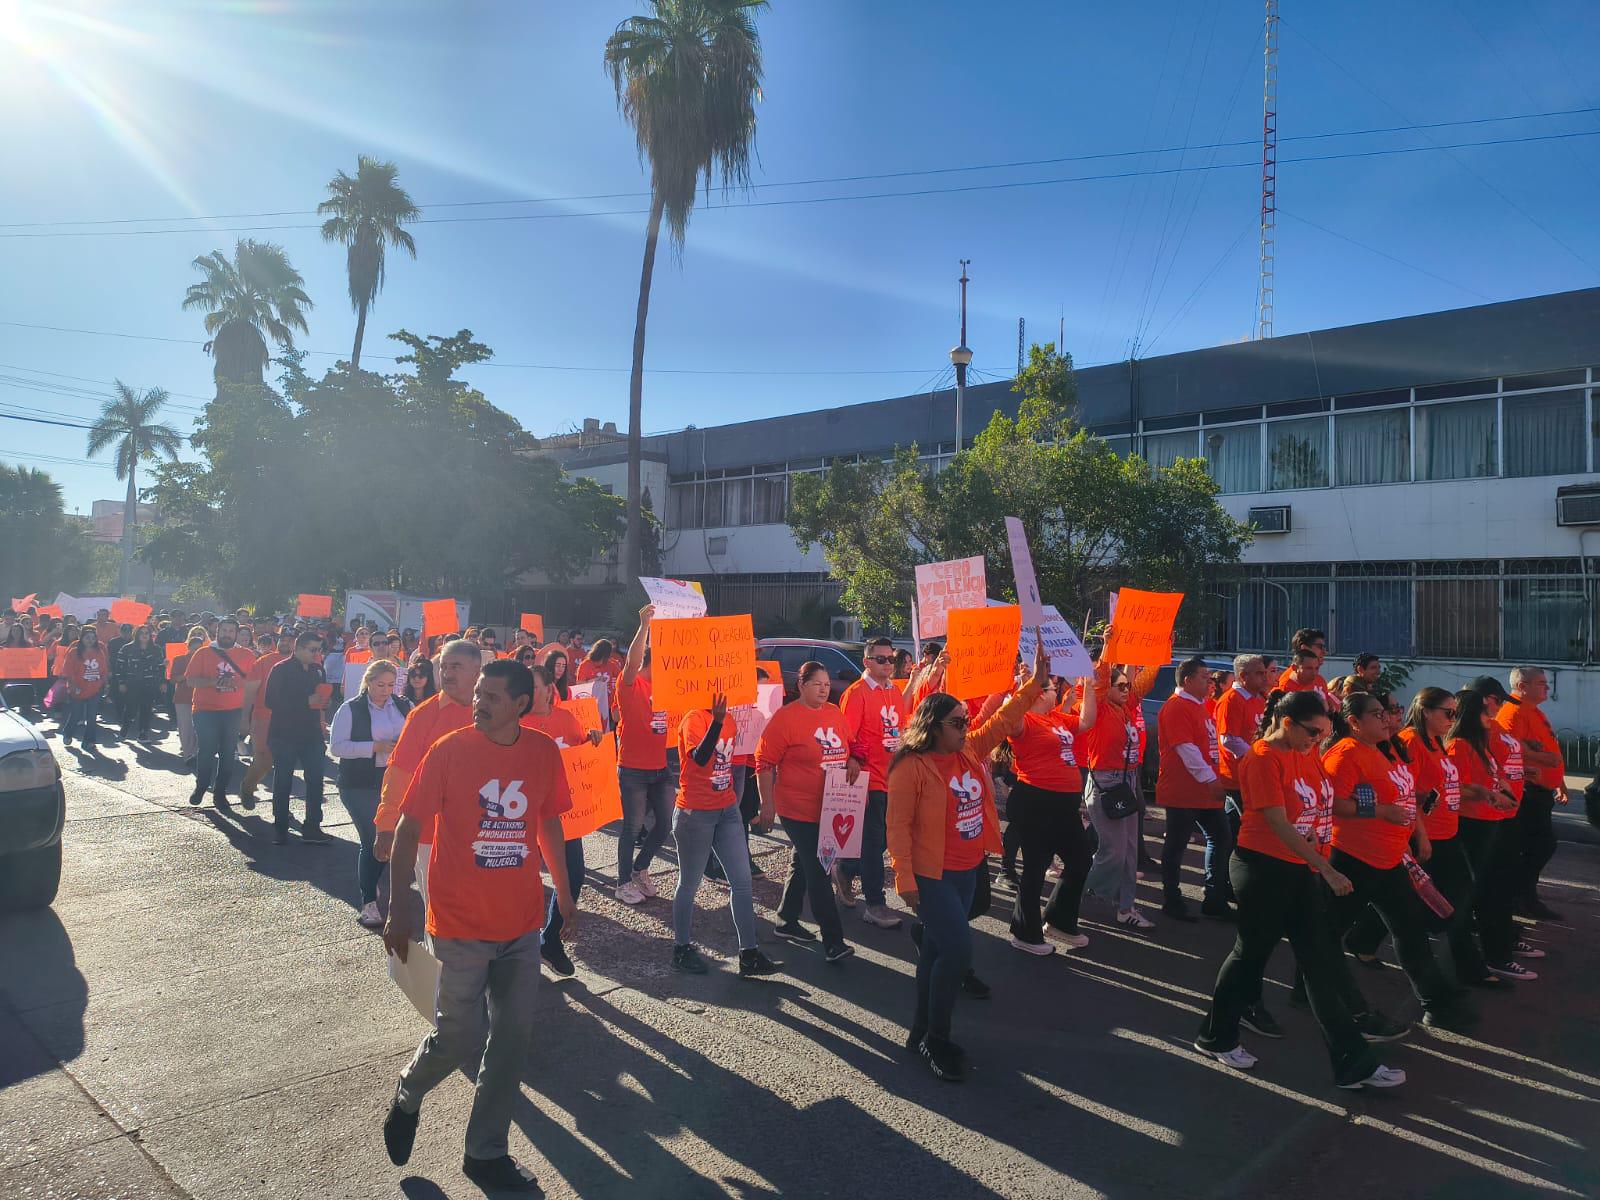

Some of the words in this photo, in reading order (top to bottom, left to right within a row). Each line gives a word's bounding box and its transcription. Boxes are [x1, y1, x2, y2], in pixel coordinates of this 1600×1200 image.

[675, 678, 699, 696] SIN
[880, 704, 899, 727] 16
[814, 727, 842, 749] 16
[949, 770, 983, 803] 16
[479, 779, 527, 819] 16
[482, 821, 491, 829] DE
[492, 821, 525, 829] ACTIVISMO
[485, 857, 518, 867] MUJERES
